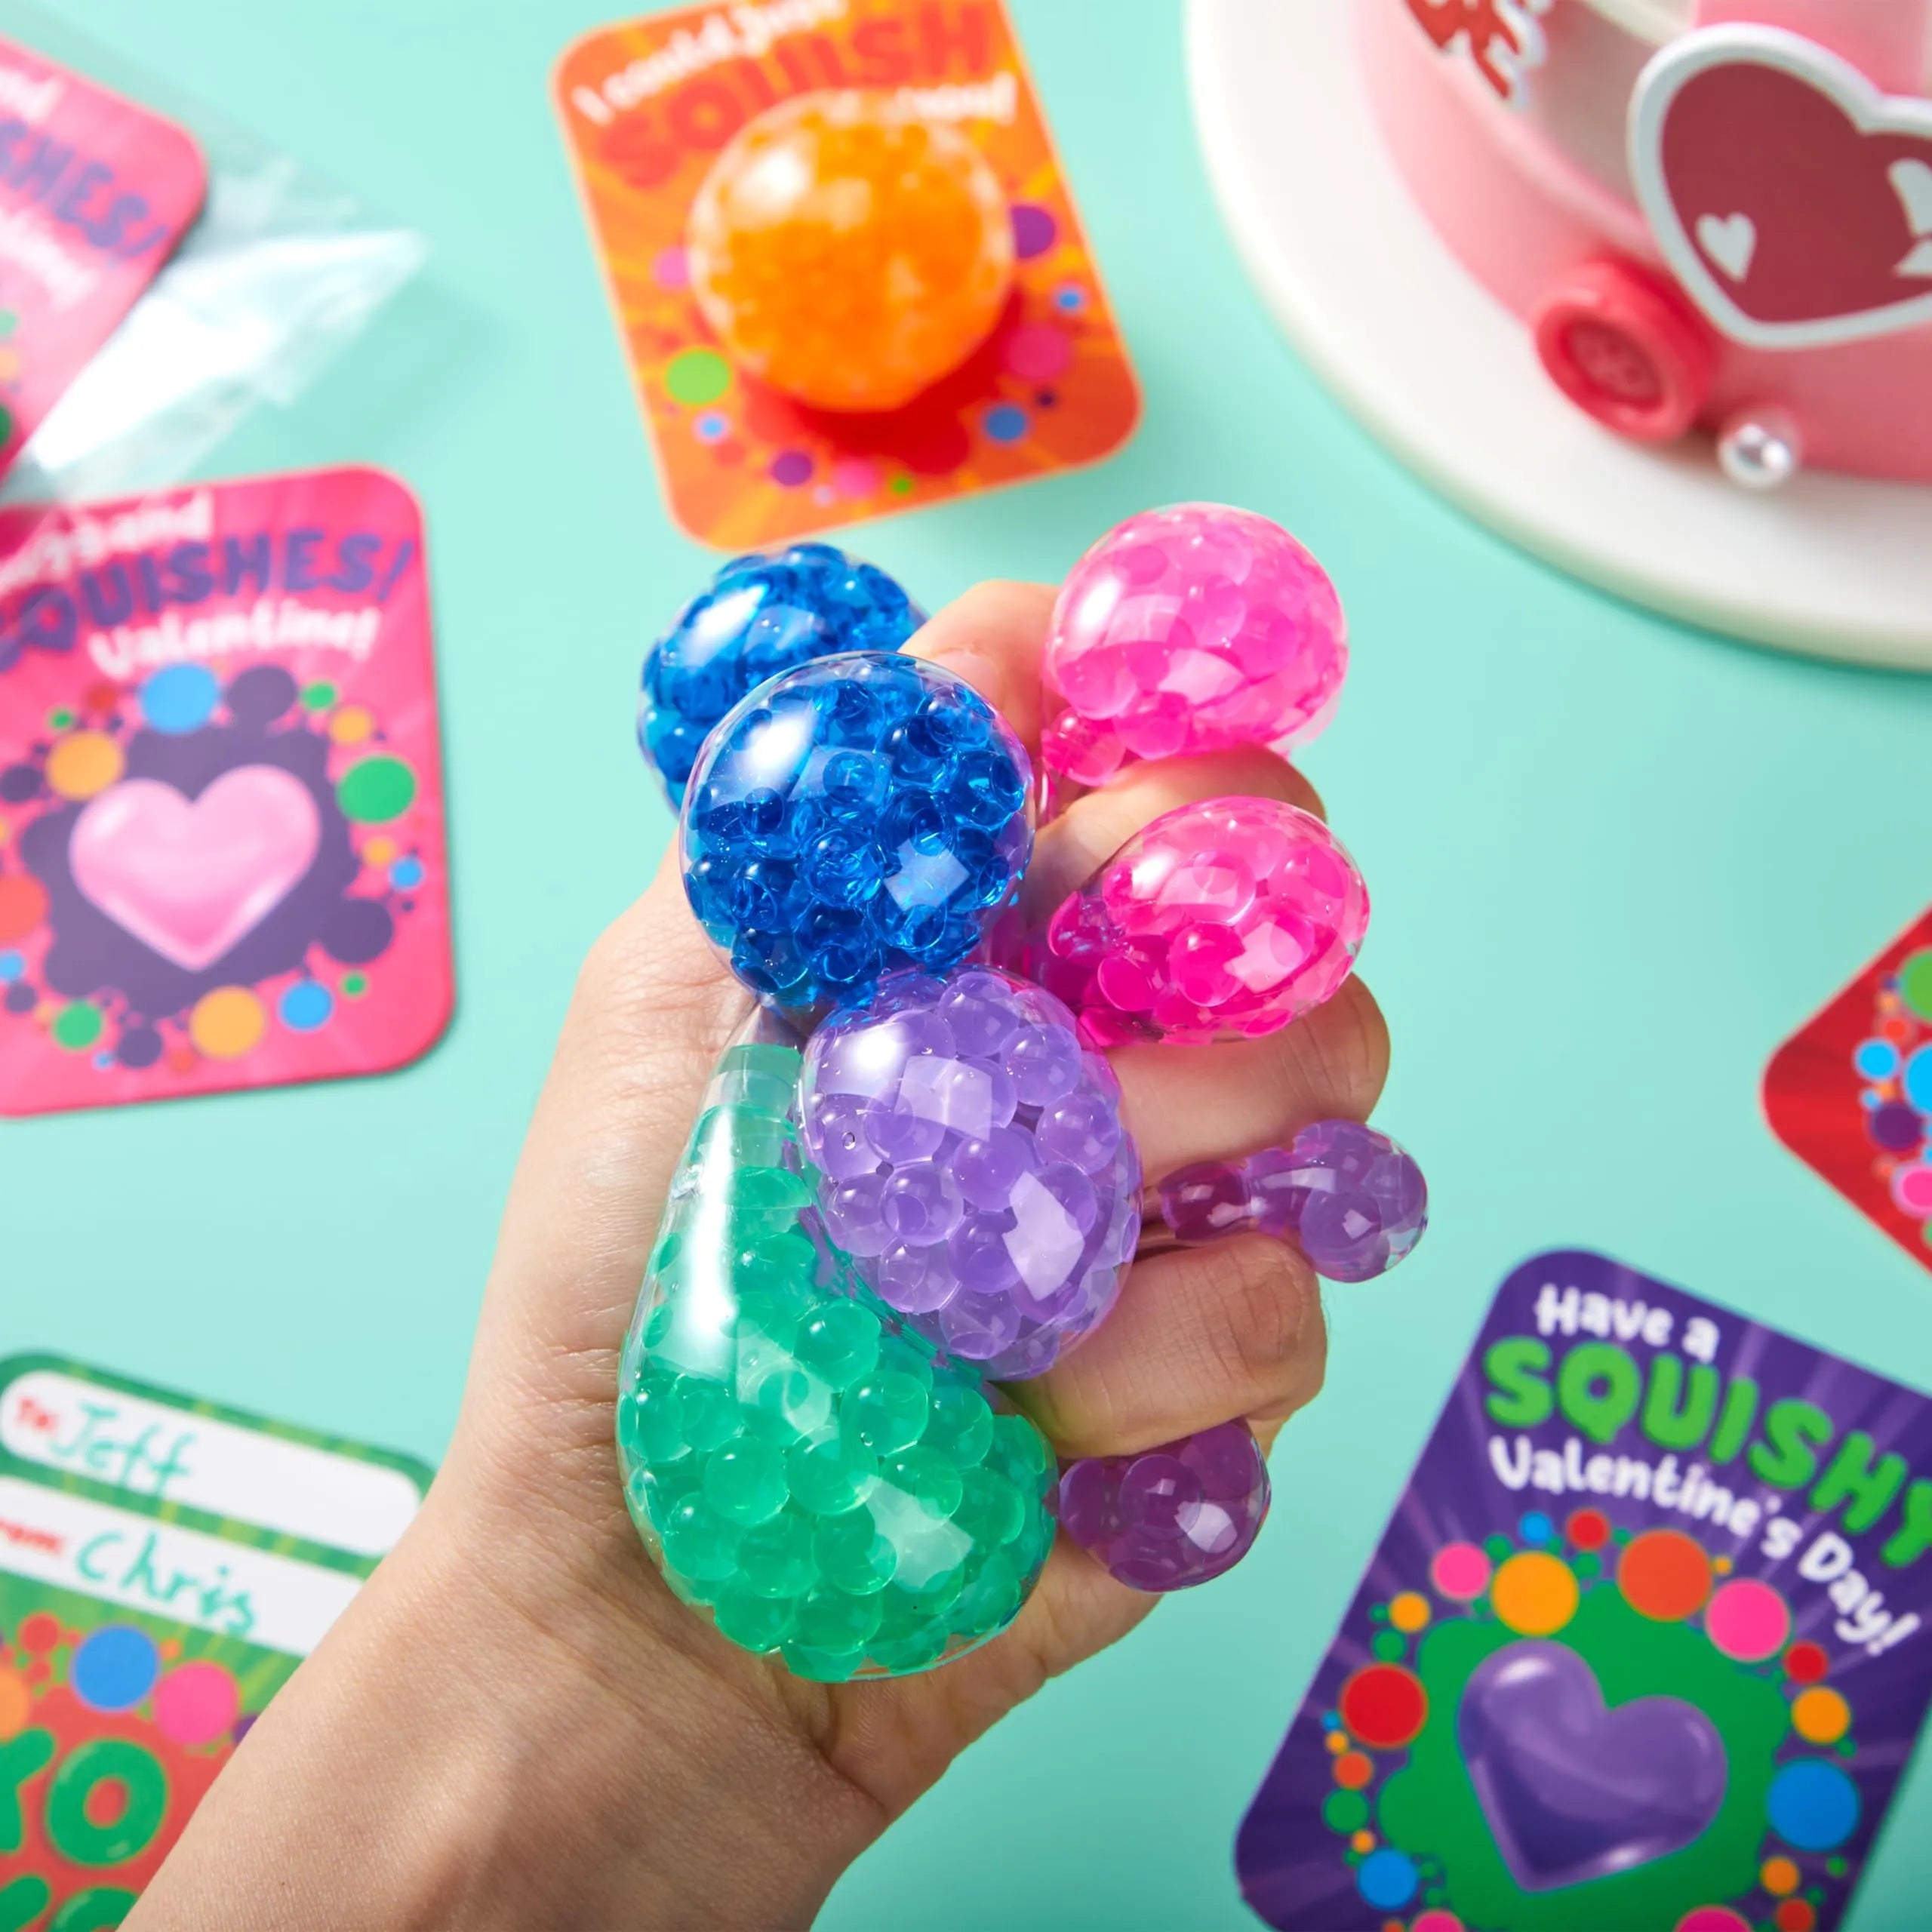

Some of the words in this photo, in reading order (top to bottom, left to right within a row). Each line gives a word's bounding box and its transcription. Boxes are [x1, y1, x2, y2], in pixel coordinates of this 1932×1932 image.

[598, 5, 990, 192] SQUISH
[87, 598, 382, 679] Valentine!
[1534, 1281, 1675, 1347] Have
[1681, 1316, 1720, 1364] a
[48, 1398, 199, 1499] Jeff
[1484, 1336, 1932, 1568] SQUISHY
[75, 1530, 257, 1639] Chris
[1488, 1435, 1804, 1560] Valentine's
[1797, 1531, 1921, 1656] Day!
